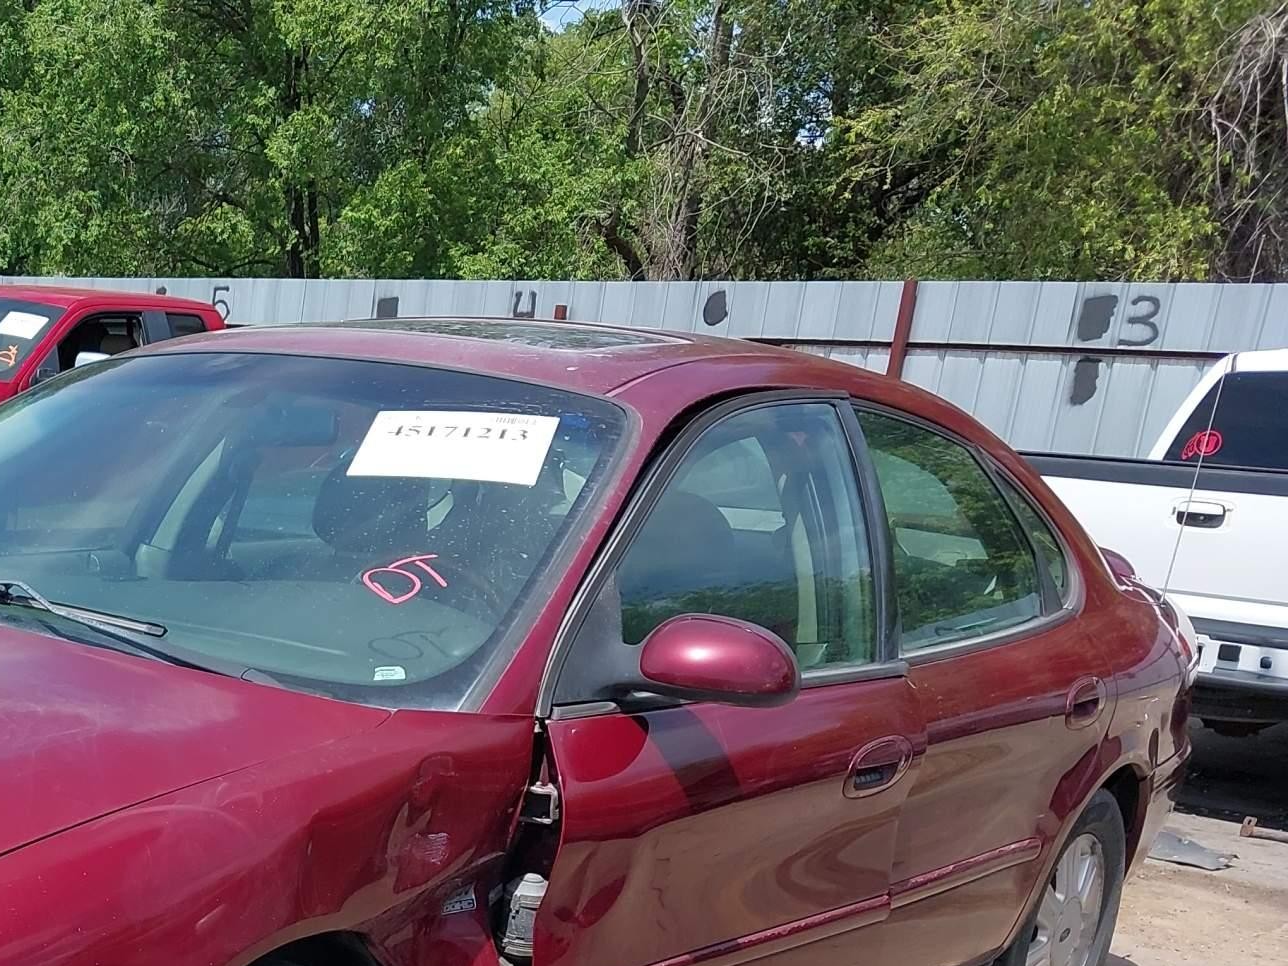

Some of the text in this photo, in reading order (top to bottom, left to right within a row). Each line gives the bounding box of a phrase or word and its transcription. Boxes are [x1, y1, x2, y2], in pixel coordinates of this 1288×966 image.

[211, 285, 231, 321] 5
[1117, 294, 1162, 347] 3
[387, 424, 531, 442] 45171213
